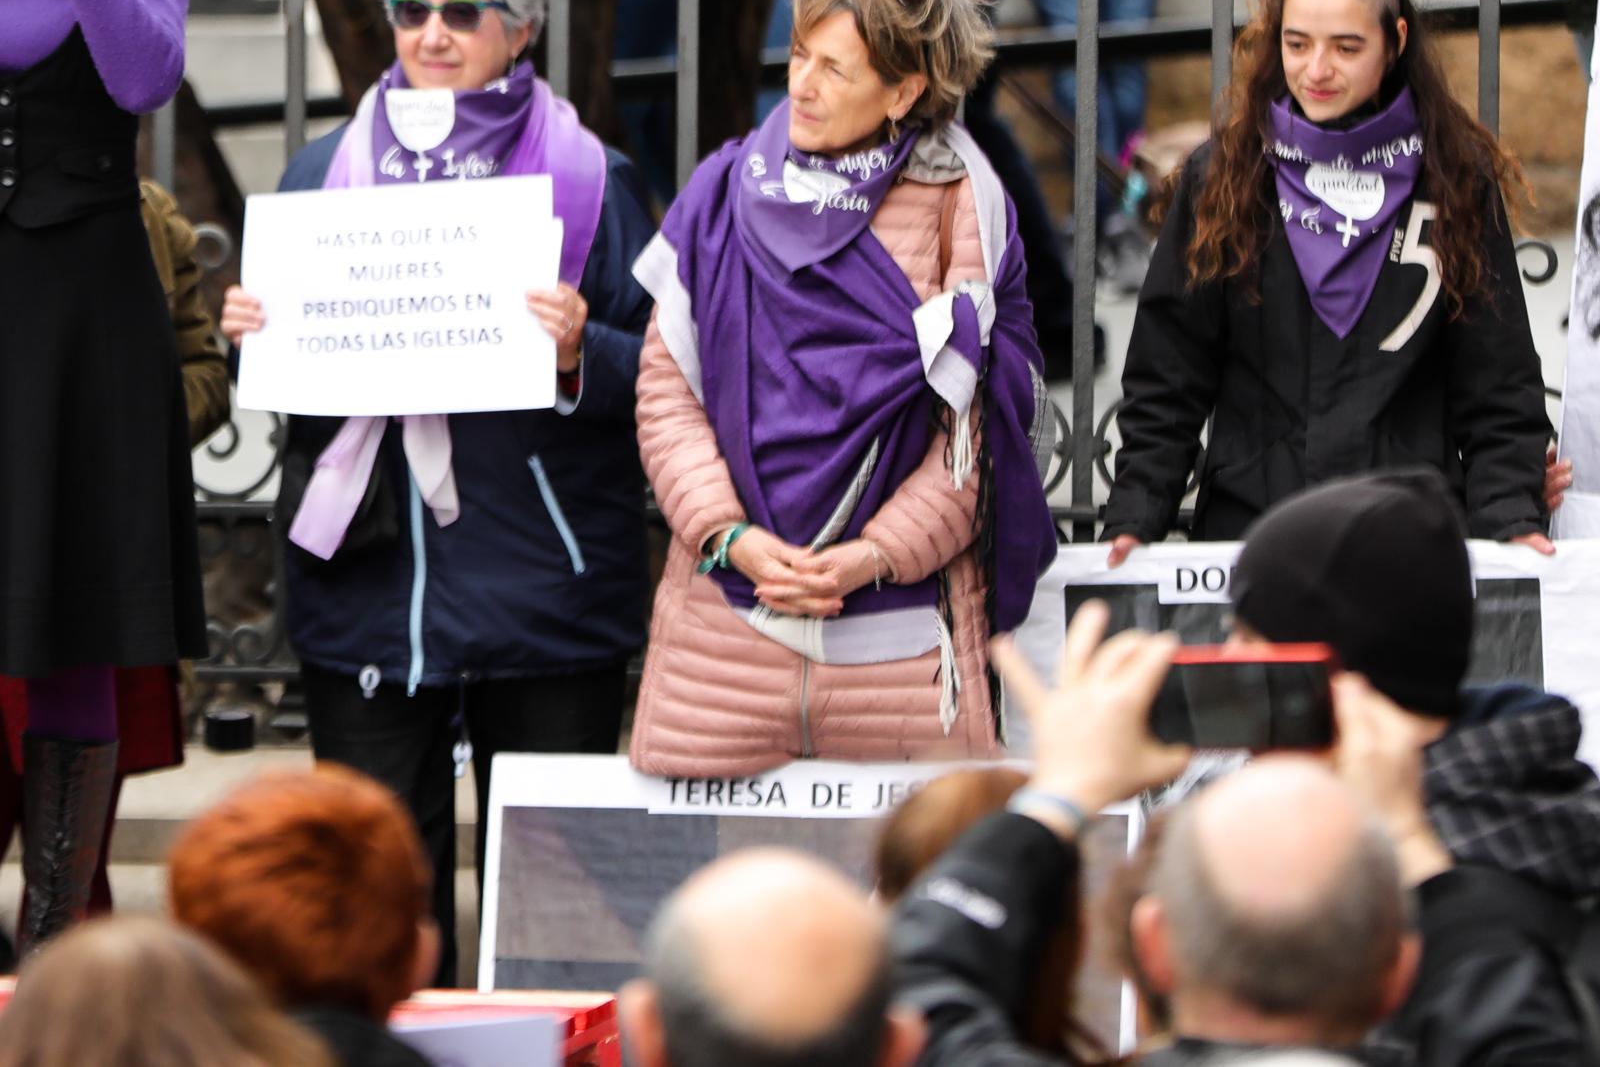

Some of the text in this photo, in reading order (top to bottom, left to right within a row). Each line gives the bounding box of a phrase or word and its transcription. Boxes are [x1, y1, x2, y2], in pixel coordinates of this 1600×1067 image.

[316, 225, 478, 249] HASTA QUE LAS
[1389, 229, 1404, 262] FIVE
[348, 261, 444, 282] MUJERES
[1379, 201, 1446, 352] 5
[303, 293, 492, 320] PREDIQUEMOS EN
[296, 327, 504, 354] TODAS LAS IGLESIAS
[664, 777, 787, 808] TERESA
[811, 781, 852, 809] DE
